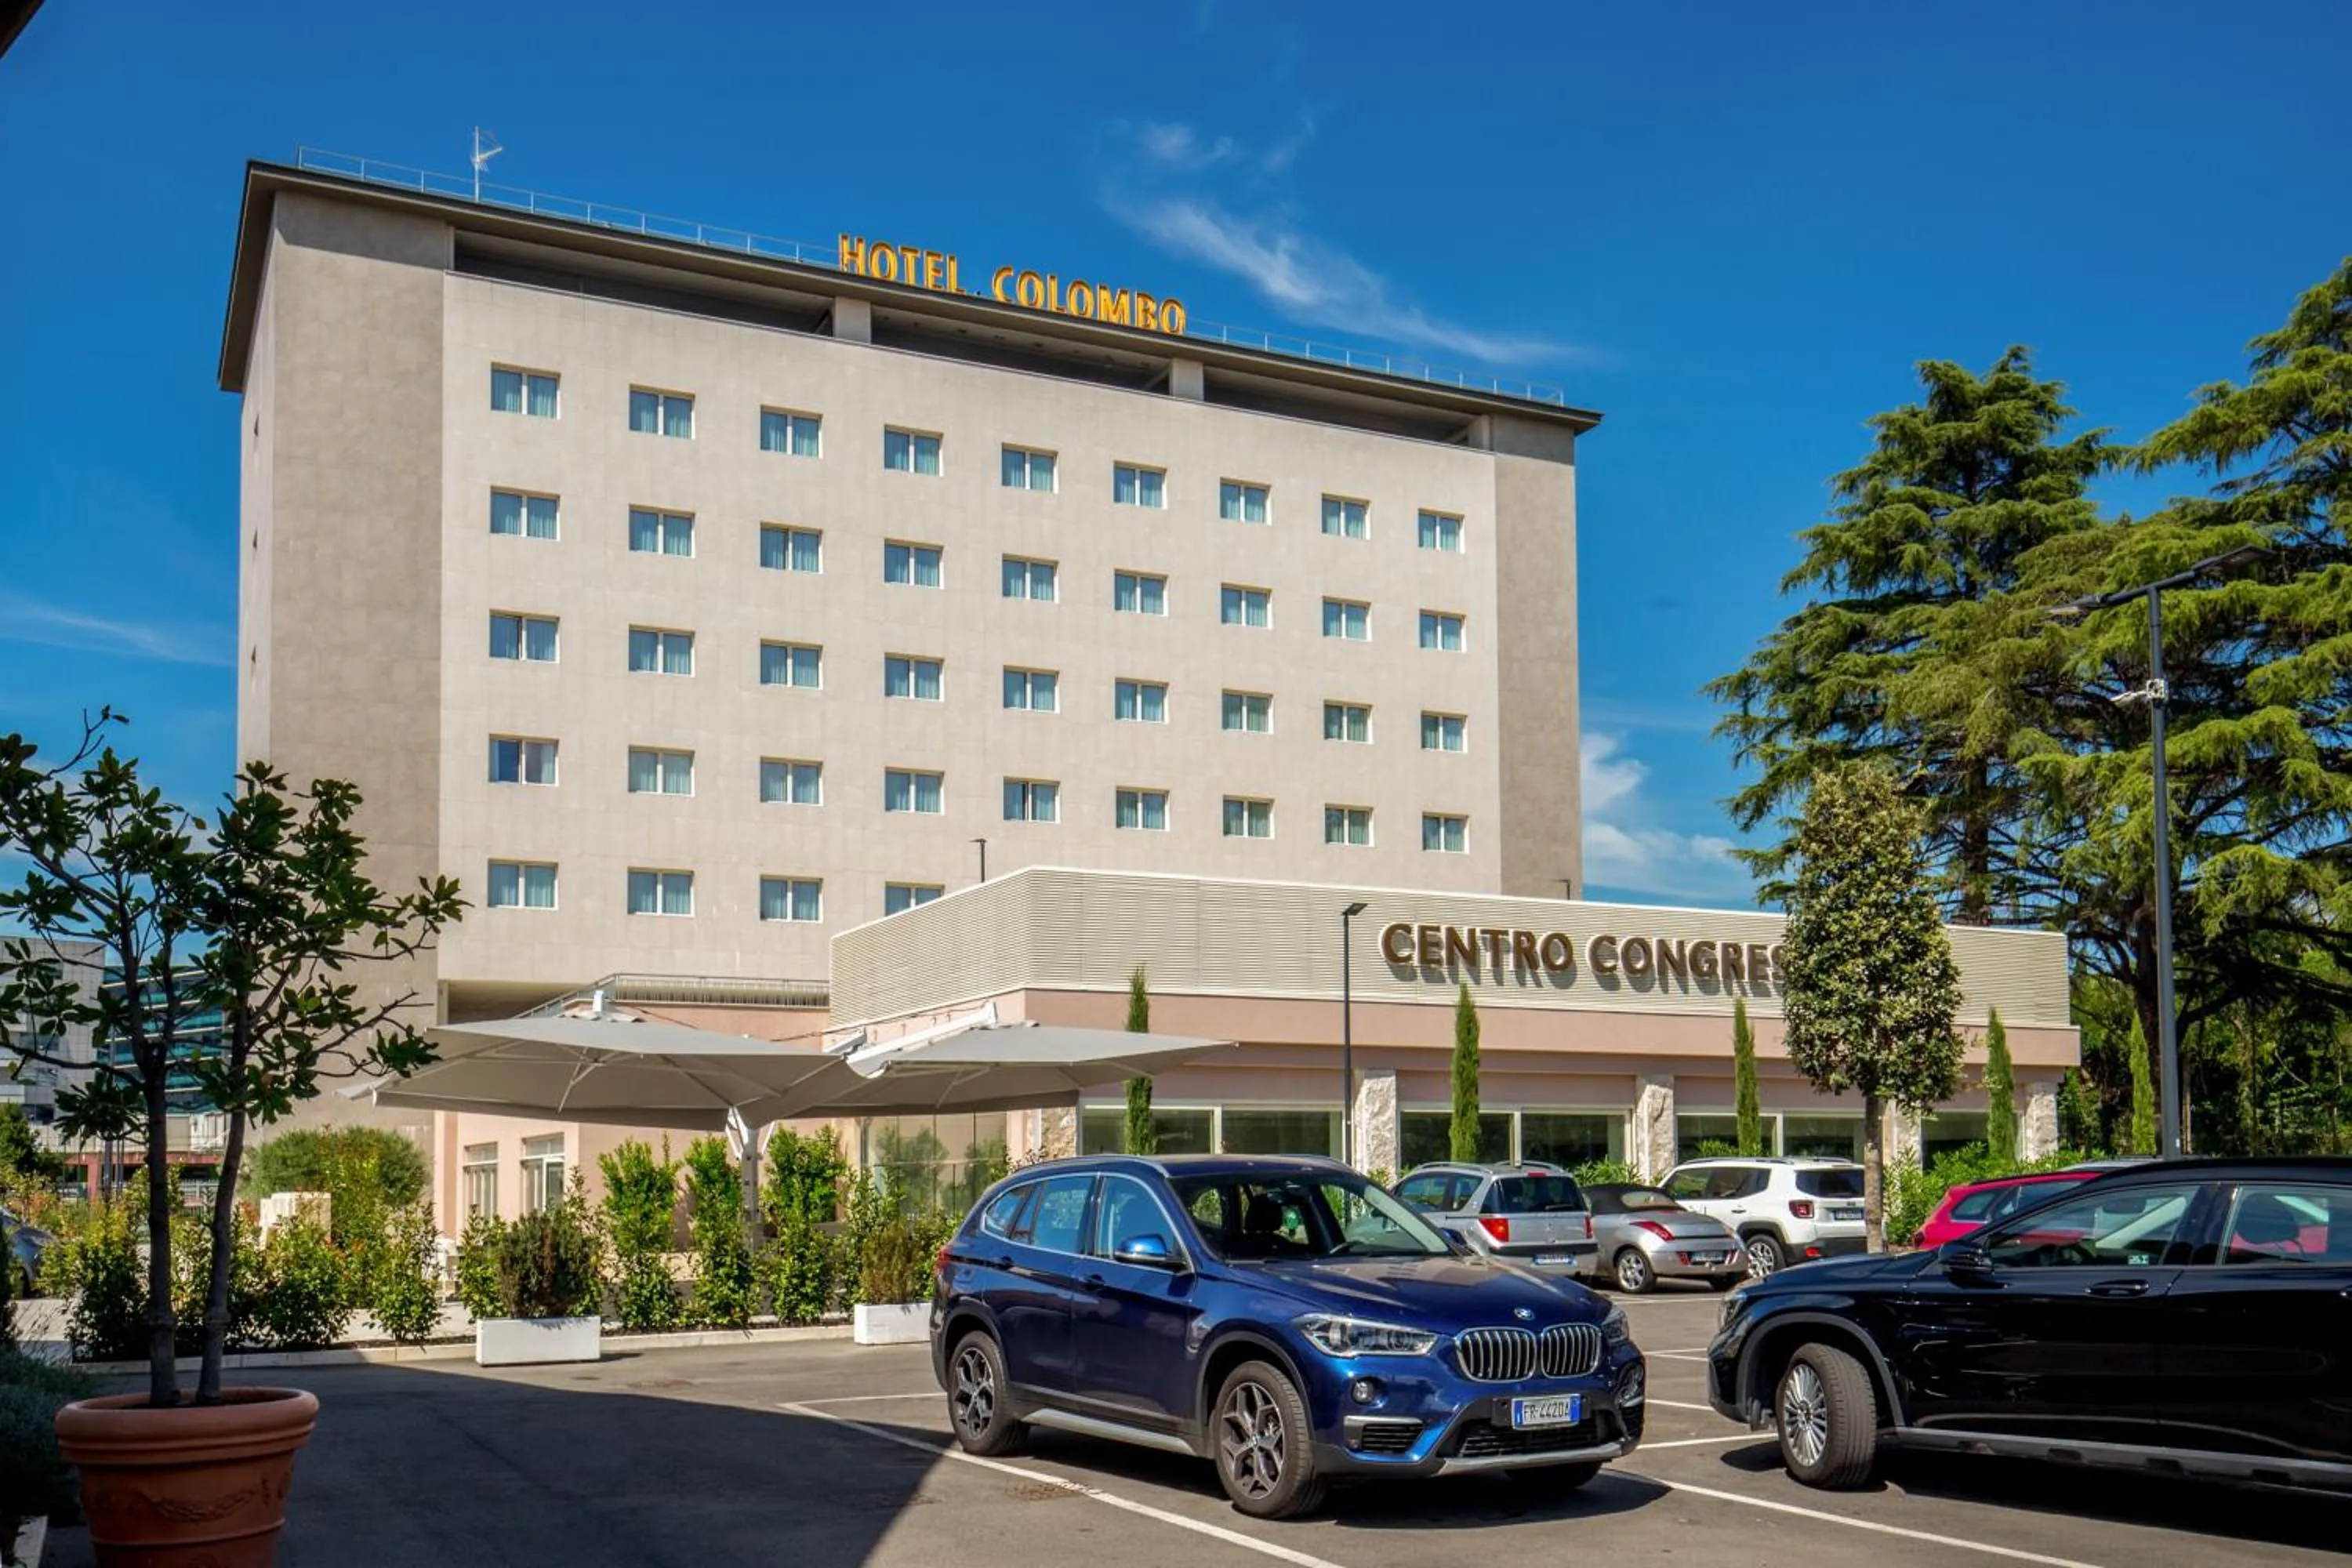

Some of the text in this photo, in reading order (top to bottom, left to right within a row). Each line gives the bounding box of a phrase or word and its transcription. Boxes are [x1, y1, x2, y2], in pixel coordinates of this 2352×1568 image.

[839, 234, 1185, 336] HOTEL COLOMBO
[1381, 923, 1574, 972] CENTRO
